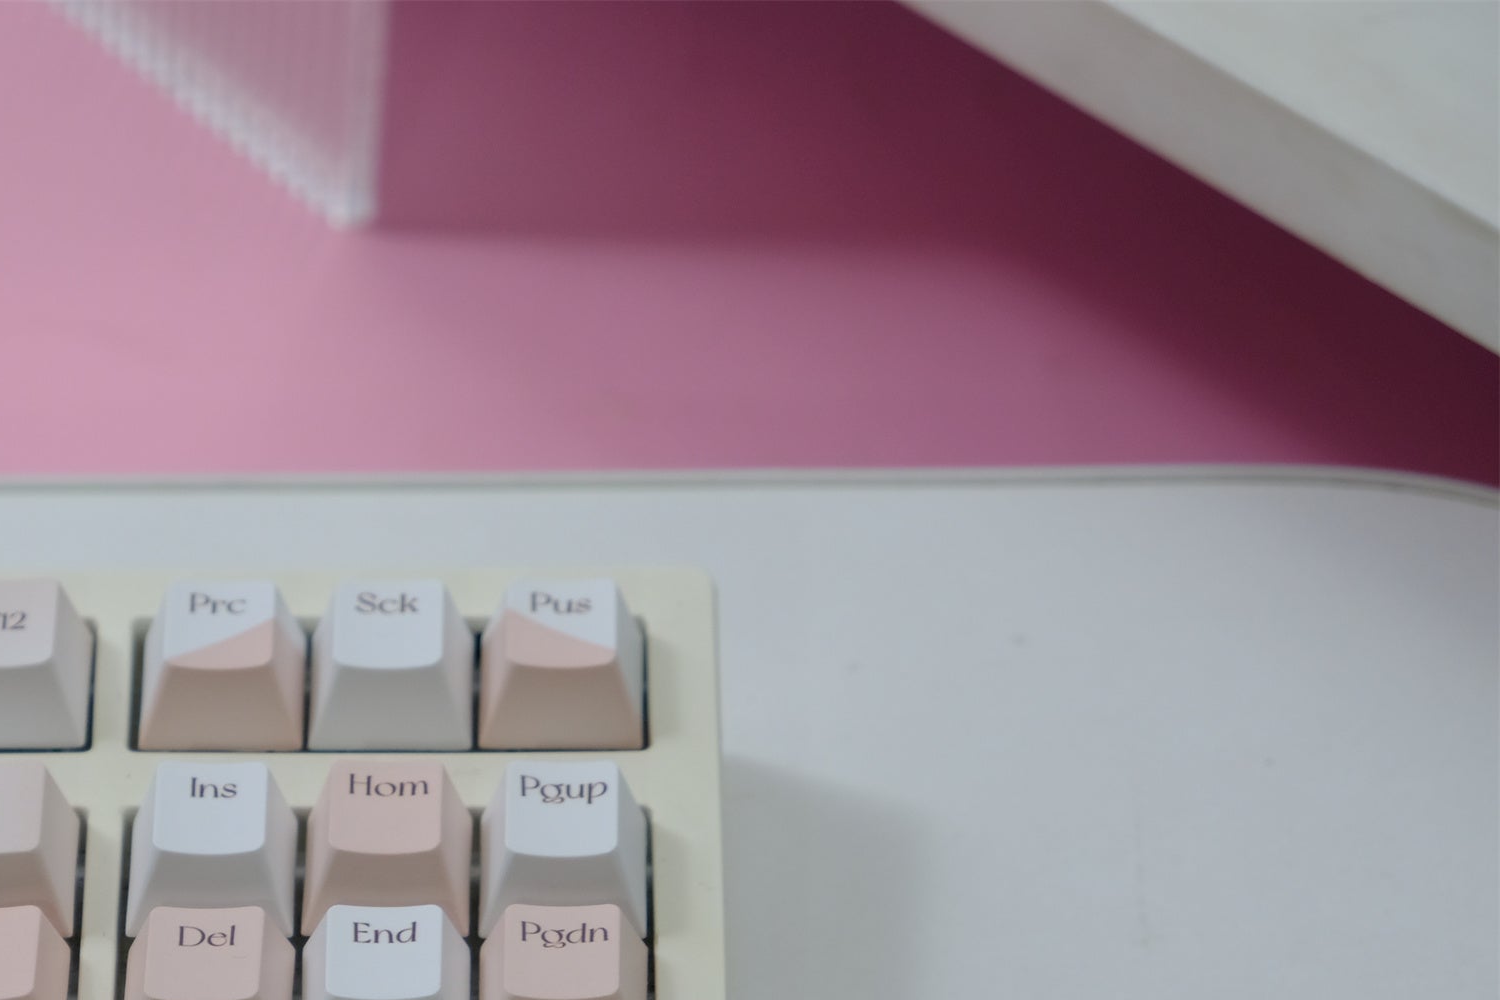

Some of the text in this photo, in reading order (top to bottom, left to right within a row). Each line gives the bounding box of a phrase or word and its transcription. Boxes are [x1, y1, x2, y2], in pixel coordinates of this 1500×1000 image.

[189, 591, 246, 615] Prc
[354, 592, 419, 615] Sck
[528, 591, 593, 615] Pus
[190, 776, 238, 799] Ins
[349, 772, 429, 797] Hom
[520, 774, 608, 805] Pgup
[178, 924, 236, 947] Del
[352, 921, 417, 944] End
[520, 920, 609, 949] Pgdn
